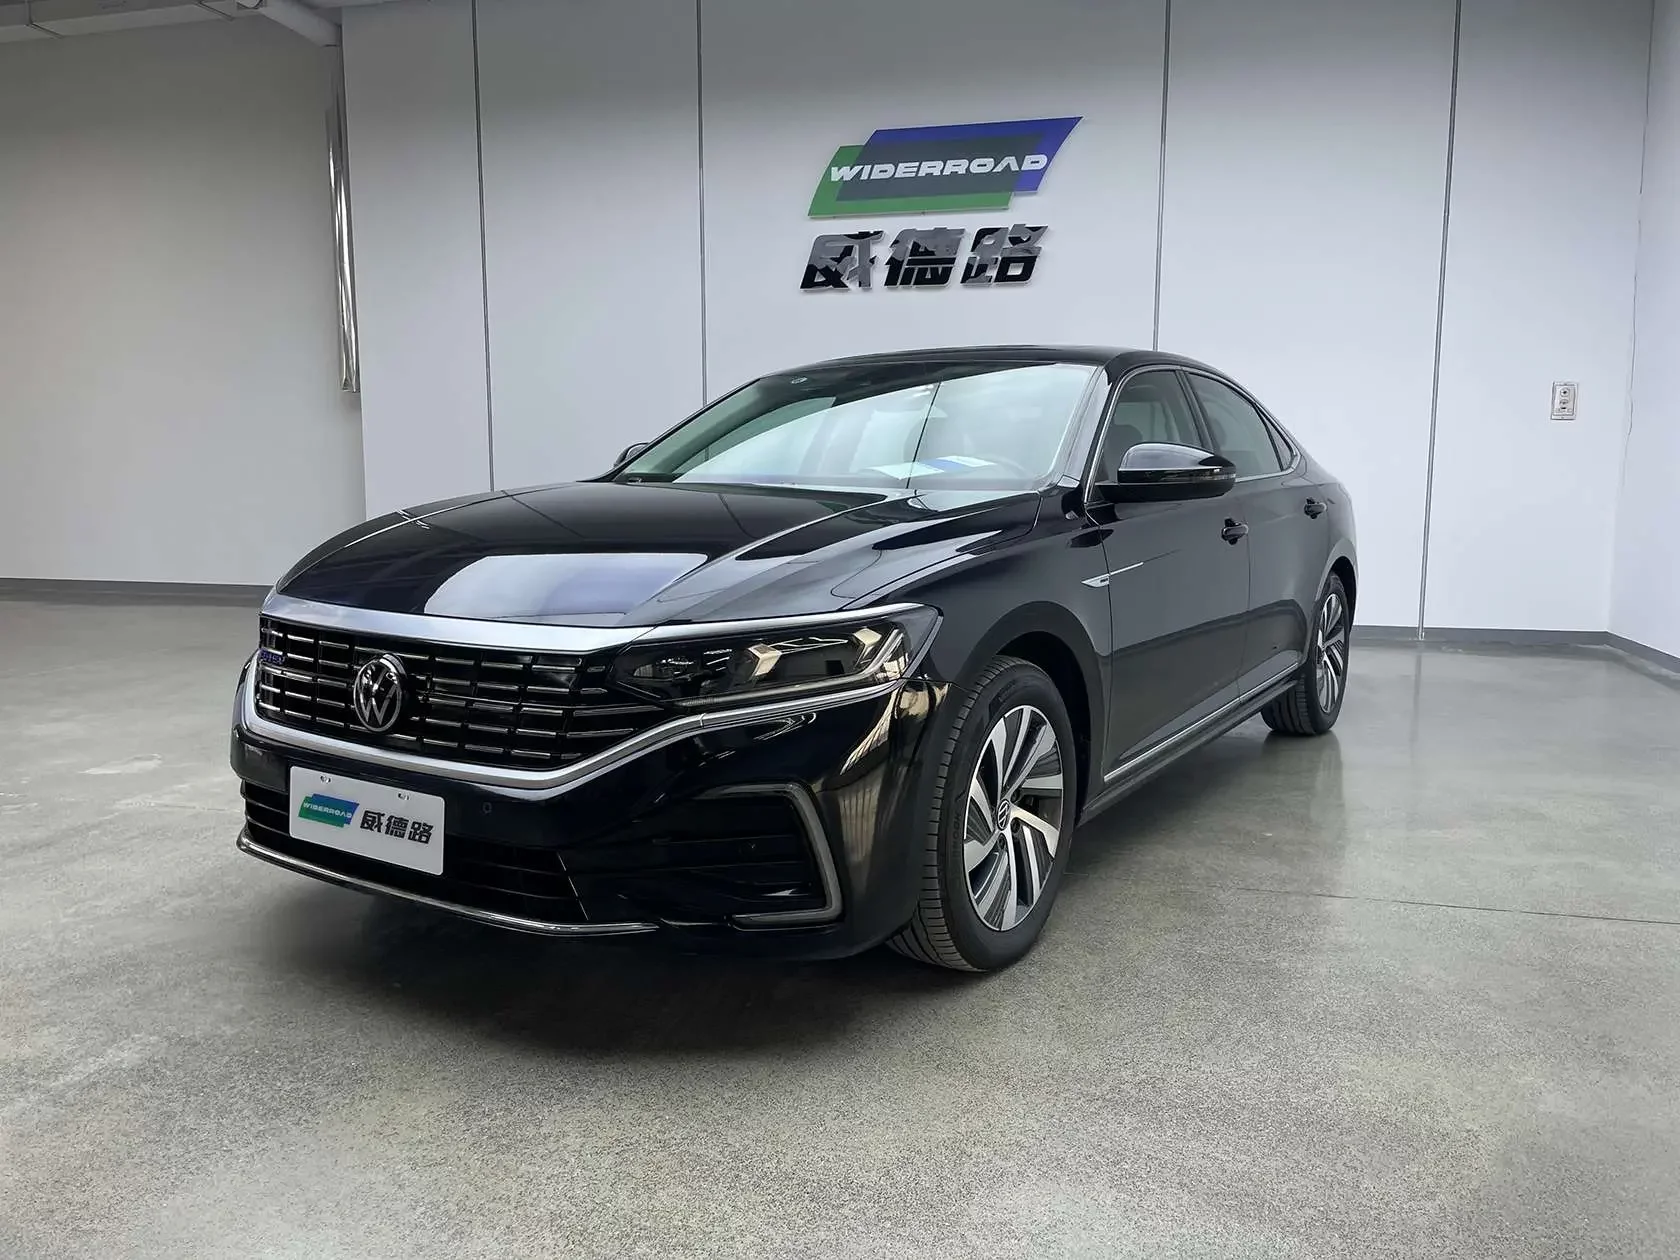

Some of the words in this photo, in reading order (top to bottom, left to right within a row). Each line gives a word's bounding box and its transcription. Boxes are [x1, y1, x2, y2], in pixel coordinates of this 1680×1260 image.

[830, 154, 1048, 182] WIDERROAD
[799, 223, 1049, 290] 威德路
[303, 802, 352, 818] WIDERROAD
[360, 810, 434, 844] 威德路
